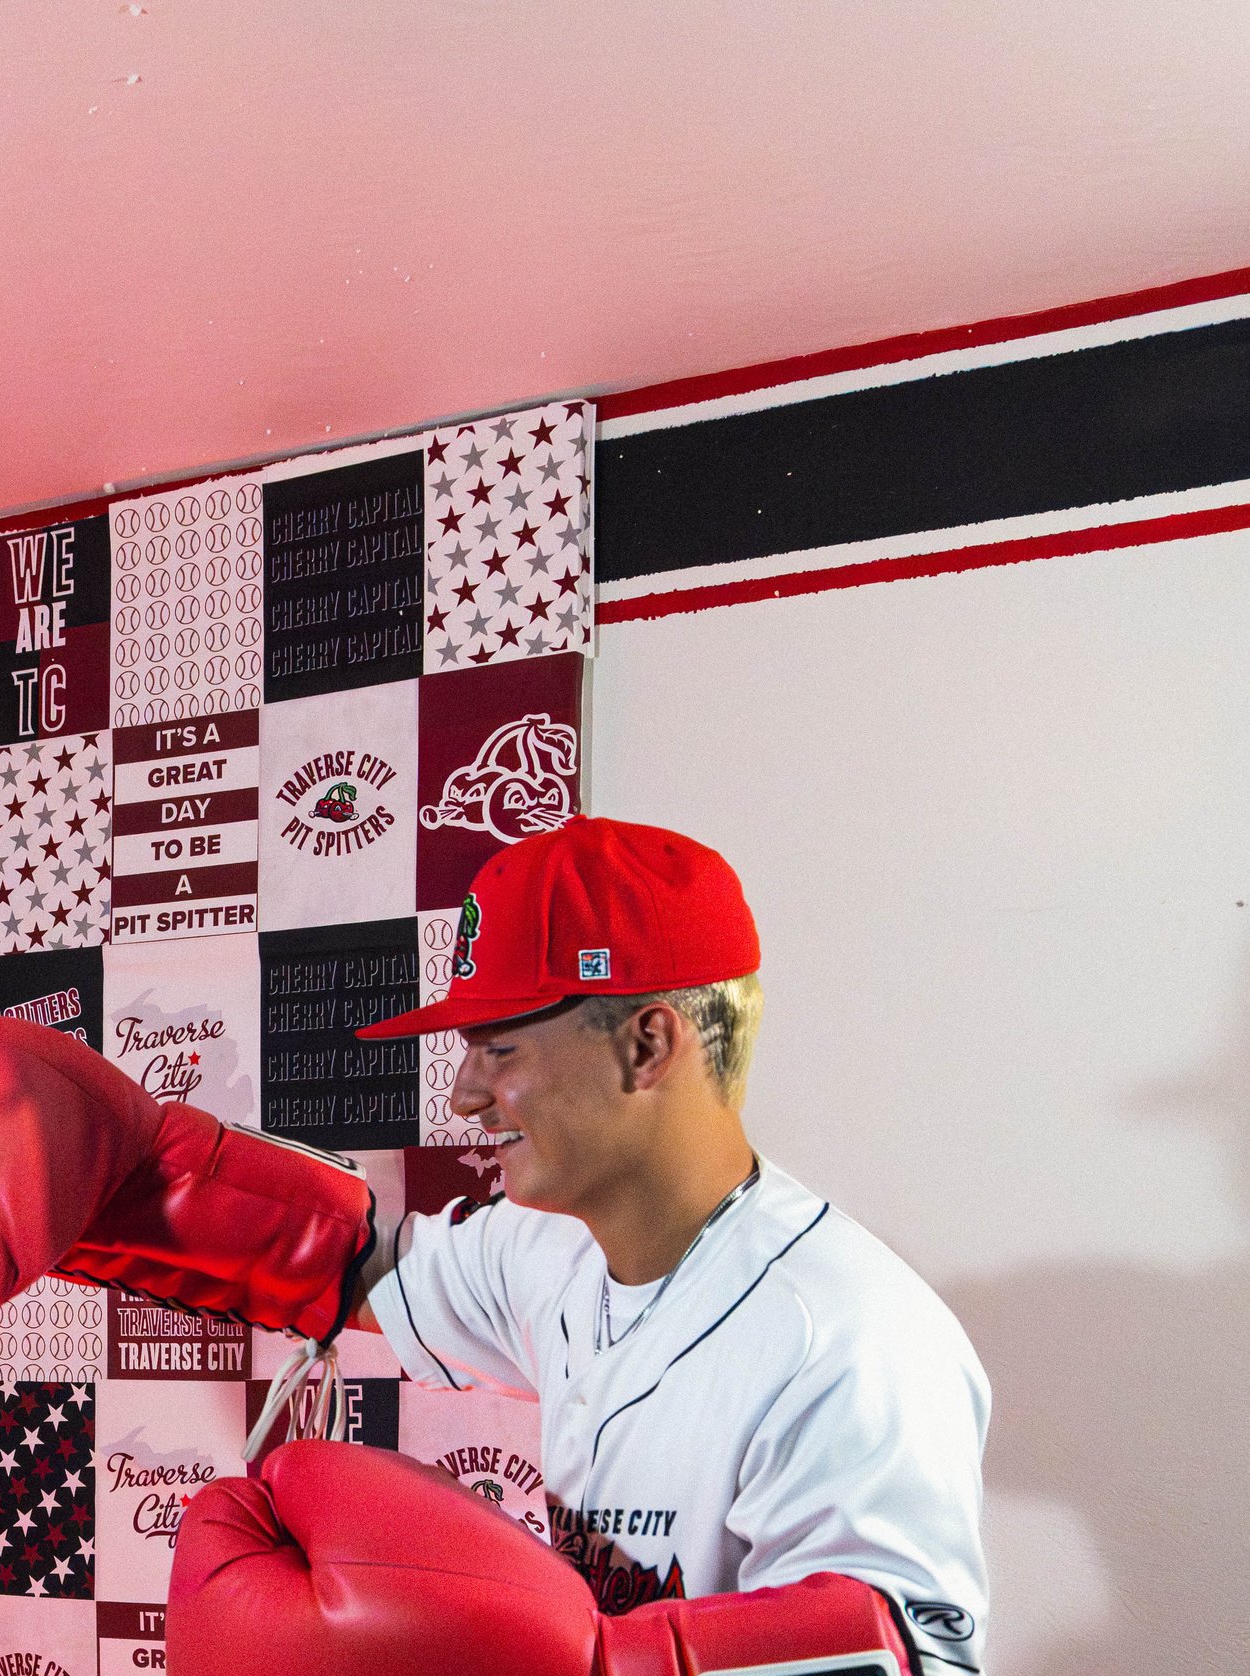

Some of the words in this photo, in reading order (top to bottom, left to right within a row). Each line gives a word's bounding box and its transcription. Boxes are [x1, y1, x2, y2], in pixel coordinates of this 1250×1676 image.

[271, 502, 340, 545] CHERRY
[348, 483, 422, 527] CAPITAL
[8, 528, 75, 604] WE
[270, 541, 340, 583] CHERRY
[346, 524, 422, 568] CAPITAL
[271, 590, 340, 632] CHERRY
[347, 576, 422, 618] CAPITAL
[16, 602, 66, 653] ARE
[271, 636, 340, 678] CHERRY
[347, 622, 422, 664] CAPITAL
[12, 664, 66, 736] TC
[155, 726, 197, 750] IT'S
[203, 723, 221, 744] A
[147, 759, 227, 786] GREAT
[275, 750, 355, 806] TRAVERSE
[356, 753, 397, 791] CITY
[160, 798, 211, 823] DAY
[280, 815, 312, 852] PIT
[312, 803, 395, 857] SPITTERS
[151, 838, 184, 861] TO
[190, 834, 222, 856] BE
[175, 875, 193, 895] A
[114, 914, 151, 936] PIT
[156, 904, 255, 932] SPITTER
[116, 1017, 225, 1057] Traverse
[141, 1053, 202, 1101] City
[118, 1342, 202, 1370] TRAVERSE
[207, 1342, 245, 1371] CITY
[107, 1452, 216, 1492] Traverse
[504, 1454, 543, 1496] CITY
[628, 1510, 677, 1536] CITY
[139, 1610, 165, 1632] IT'
